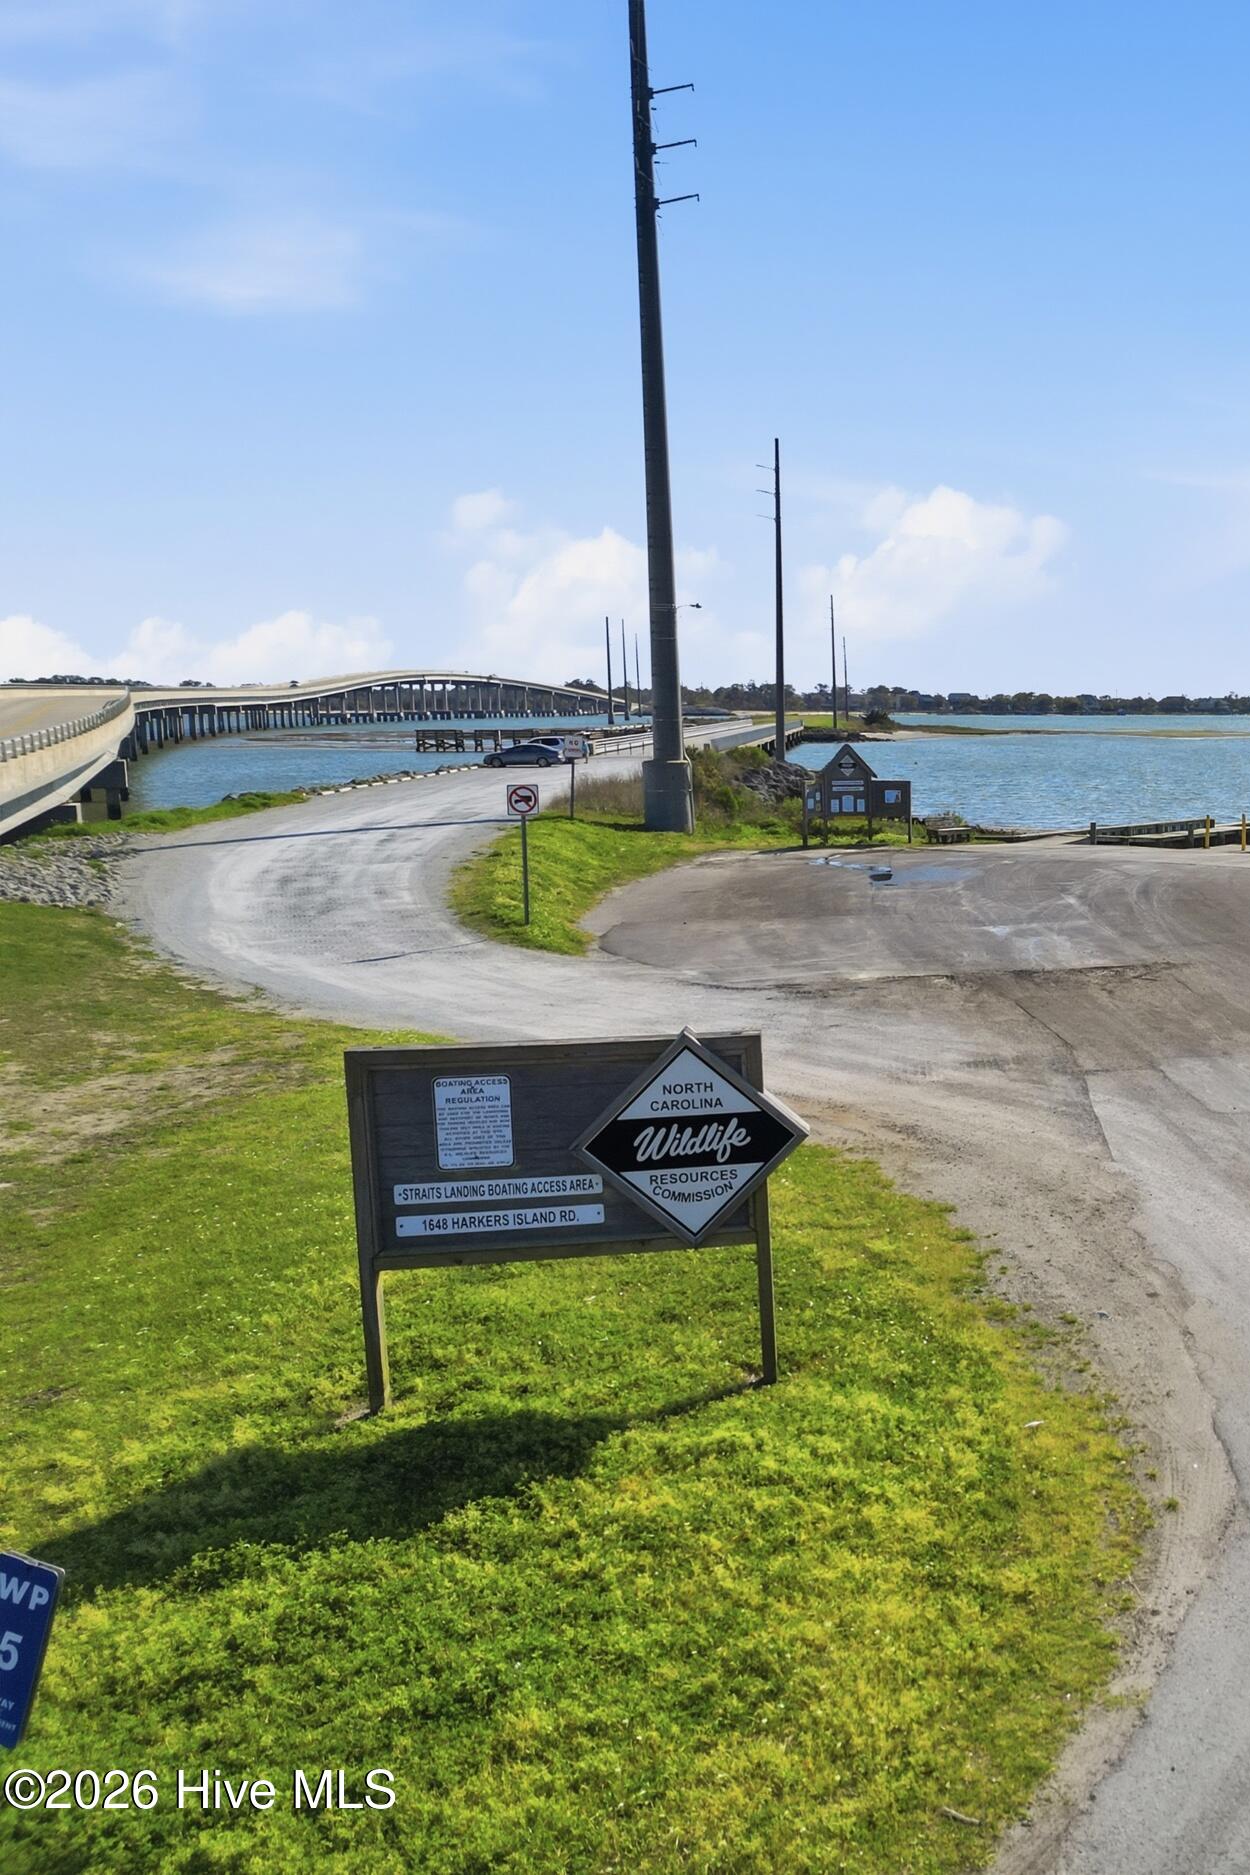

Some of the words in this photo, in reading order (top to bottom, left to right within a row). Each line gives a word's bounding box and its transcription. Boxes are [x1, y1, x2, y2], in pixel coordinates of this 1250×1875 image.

[436, 1080, 473, 1088] BOATING
[474, 1078, 508, 1086] ACCESS
[460, 1087, 485, 1095] AREA
[662, 1081, 714, 1096] NORTH
[445, 1096, 501, 1104] REGULATION
[650, 1097, 724, 1112] CAROLINA
[633, 1117, 752, 1163] Wildlife
[649, 1169, 738, 1186] RESOURCES
[402, 1187, 442, 1201] STRAITS
[444, 1184, 486, 1199] LANDING
[488, 1182, 530, 1196] BOATING
[531, 1180, 568, 1194] ACCESS
[569, 1178, 595, 1191] AREA
[652, 1181, 734, 1202] COMMISSION
[422, 1217, 449, 1232] 1648
[451, 1214, 510, 1229] HARKERS
[513, 1211, 556, 1226] ISLAND
[560, 1210, 580, 1223] RD.
